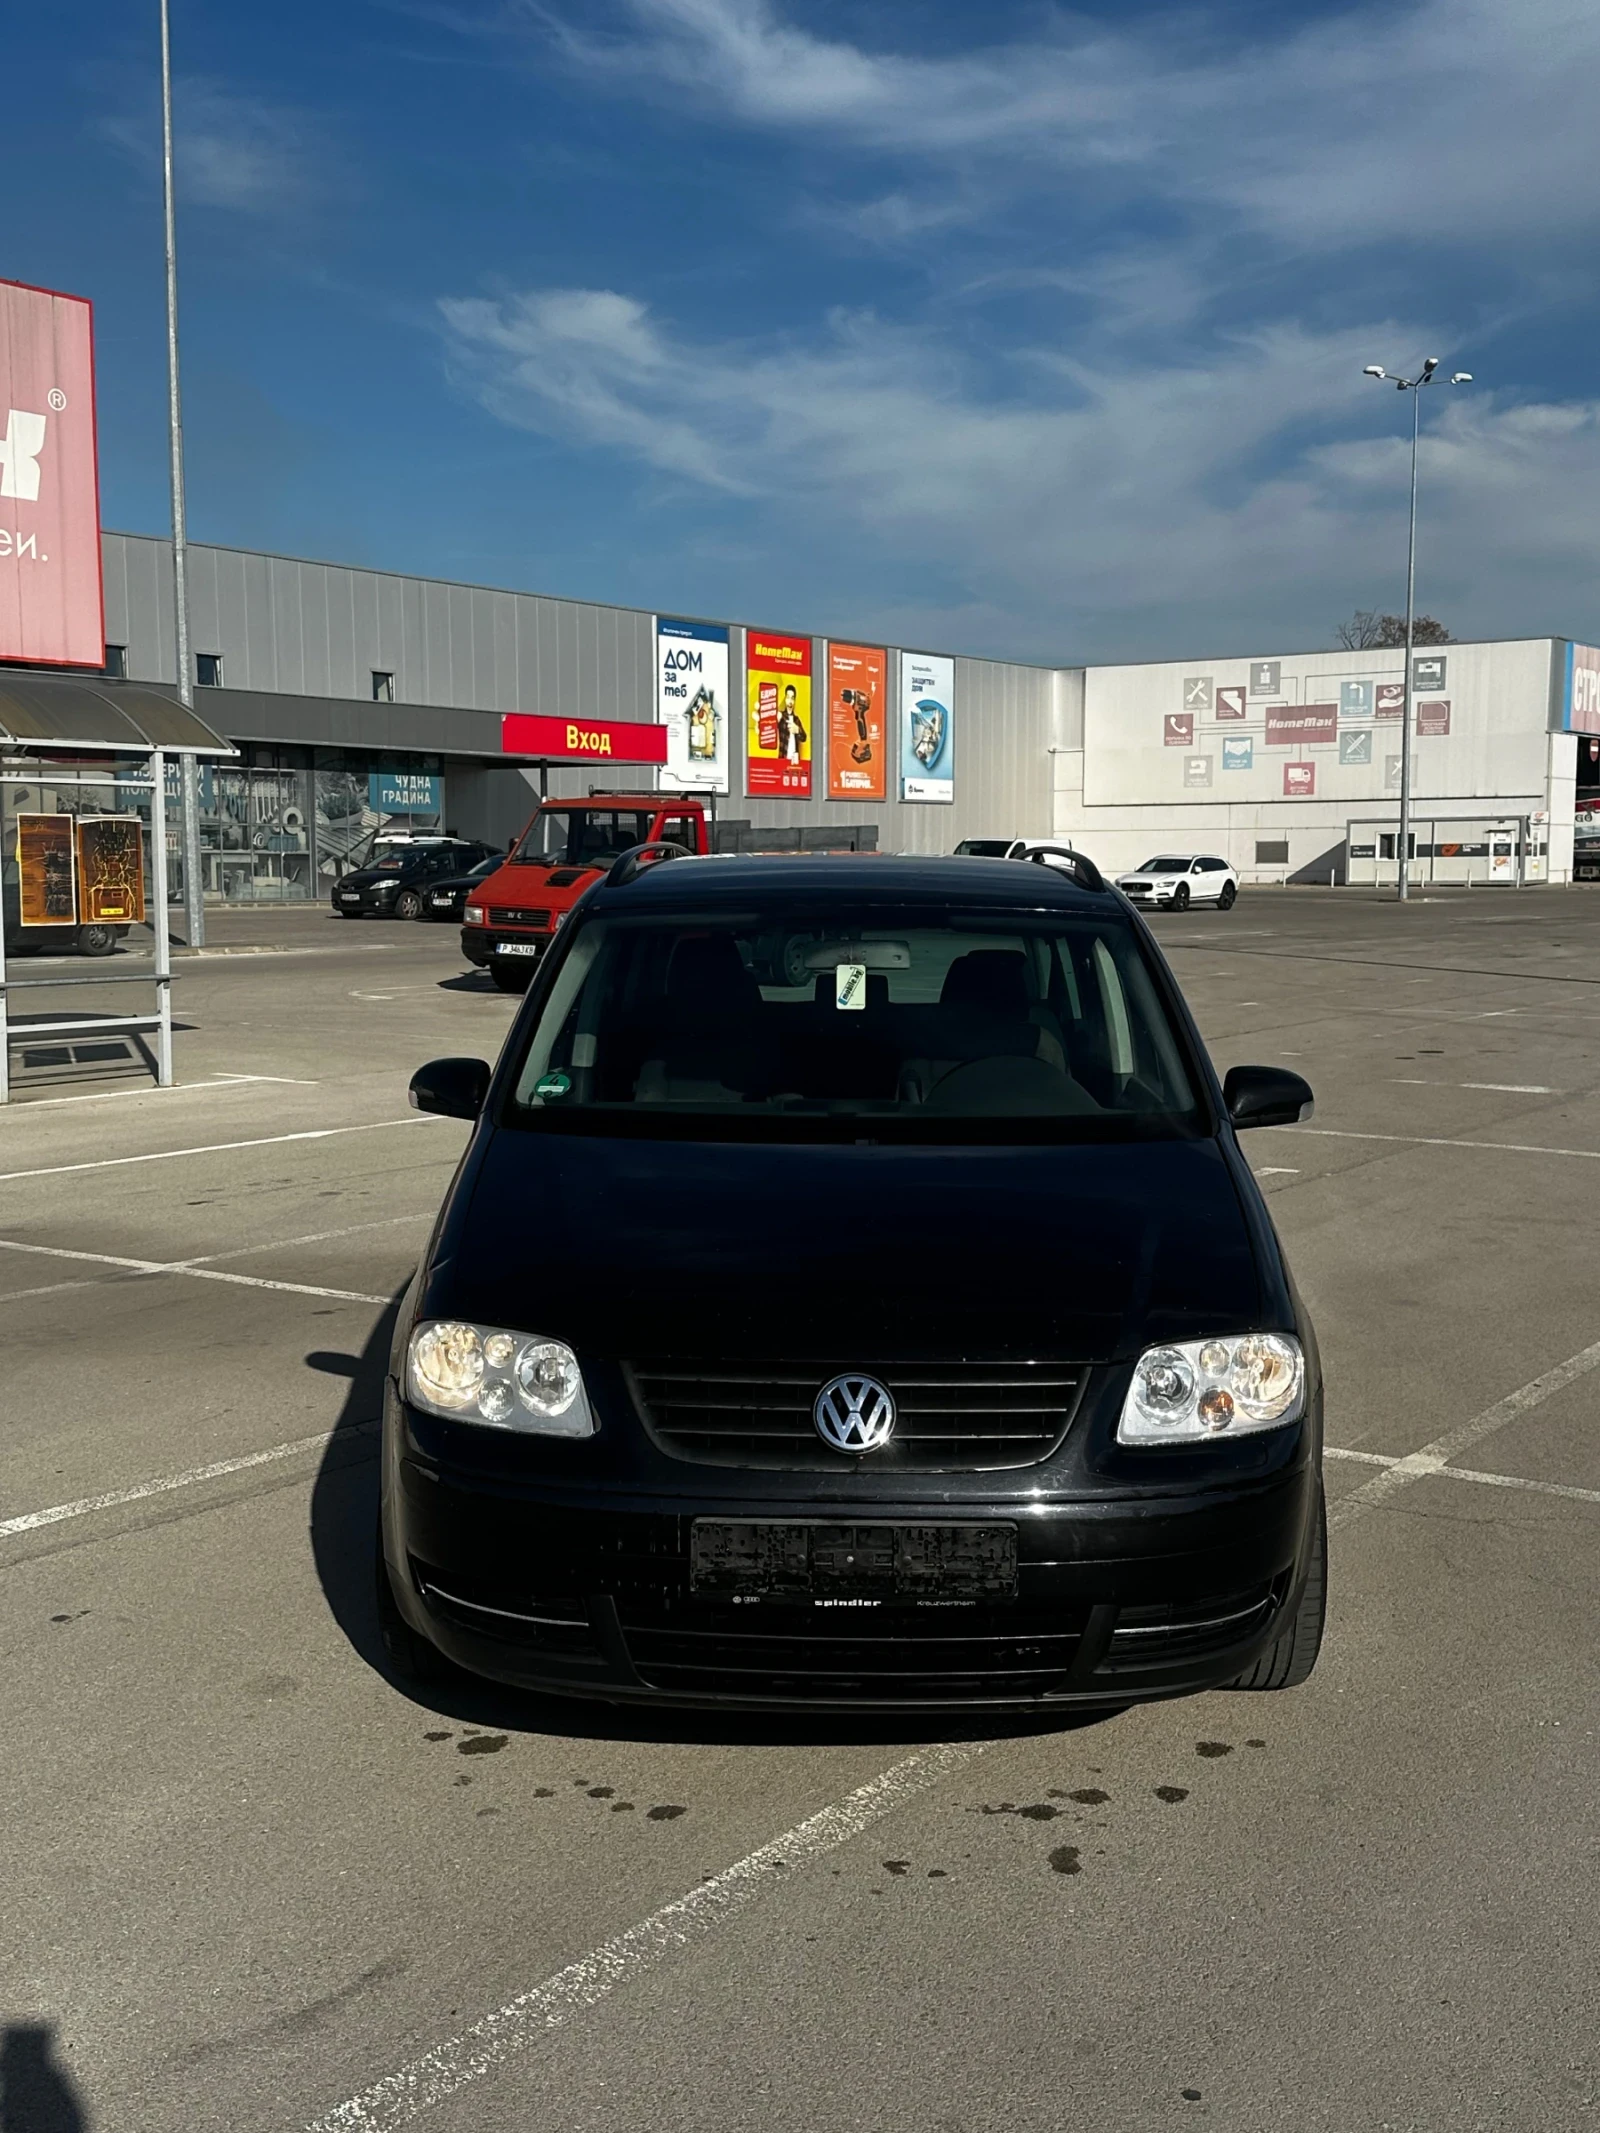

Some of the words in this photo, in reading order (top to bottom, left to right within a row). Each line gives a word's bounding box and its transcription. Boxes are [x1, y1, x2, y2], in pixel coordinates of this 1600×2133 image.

[664, 648, 702, 673] ДОМ
[755, 643, 803, 661] HomeMax
[665, 672, 677, 682] за
[1574, 666, 1600, 714] СТР
[1268, 717, 1333, 729] HomeMax
[566, 724, 611, 755] Вход
[395, 774, 432, 791] ЧУДНА
[382, 790, 432, 807] ГРАДИНА
[814, 1599, 882, 1607] spindler
